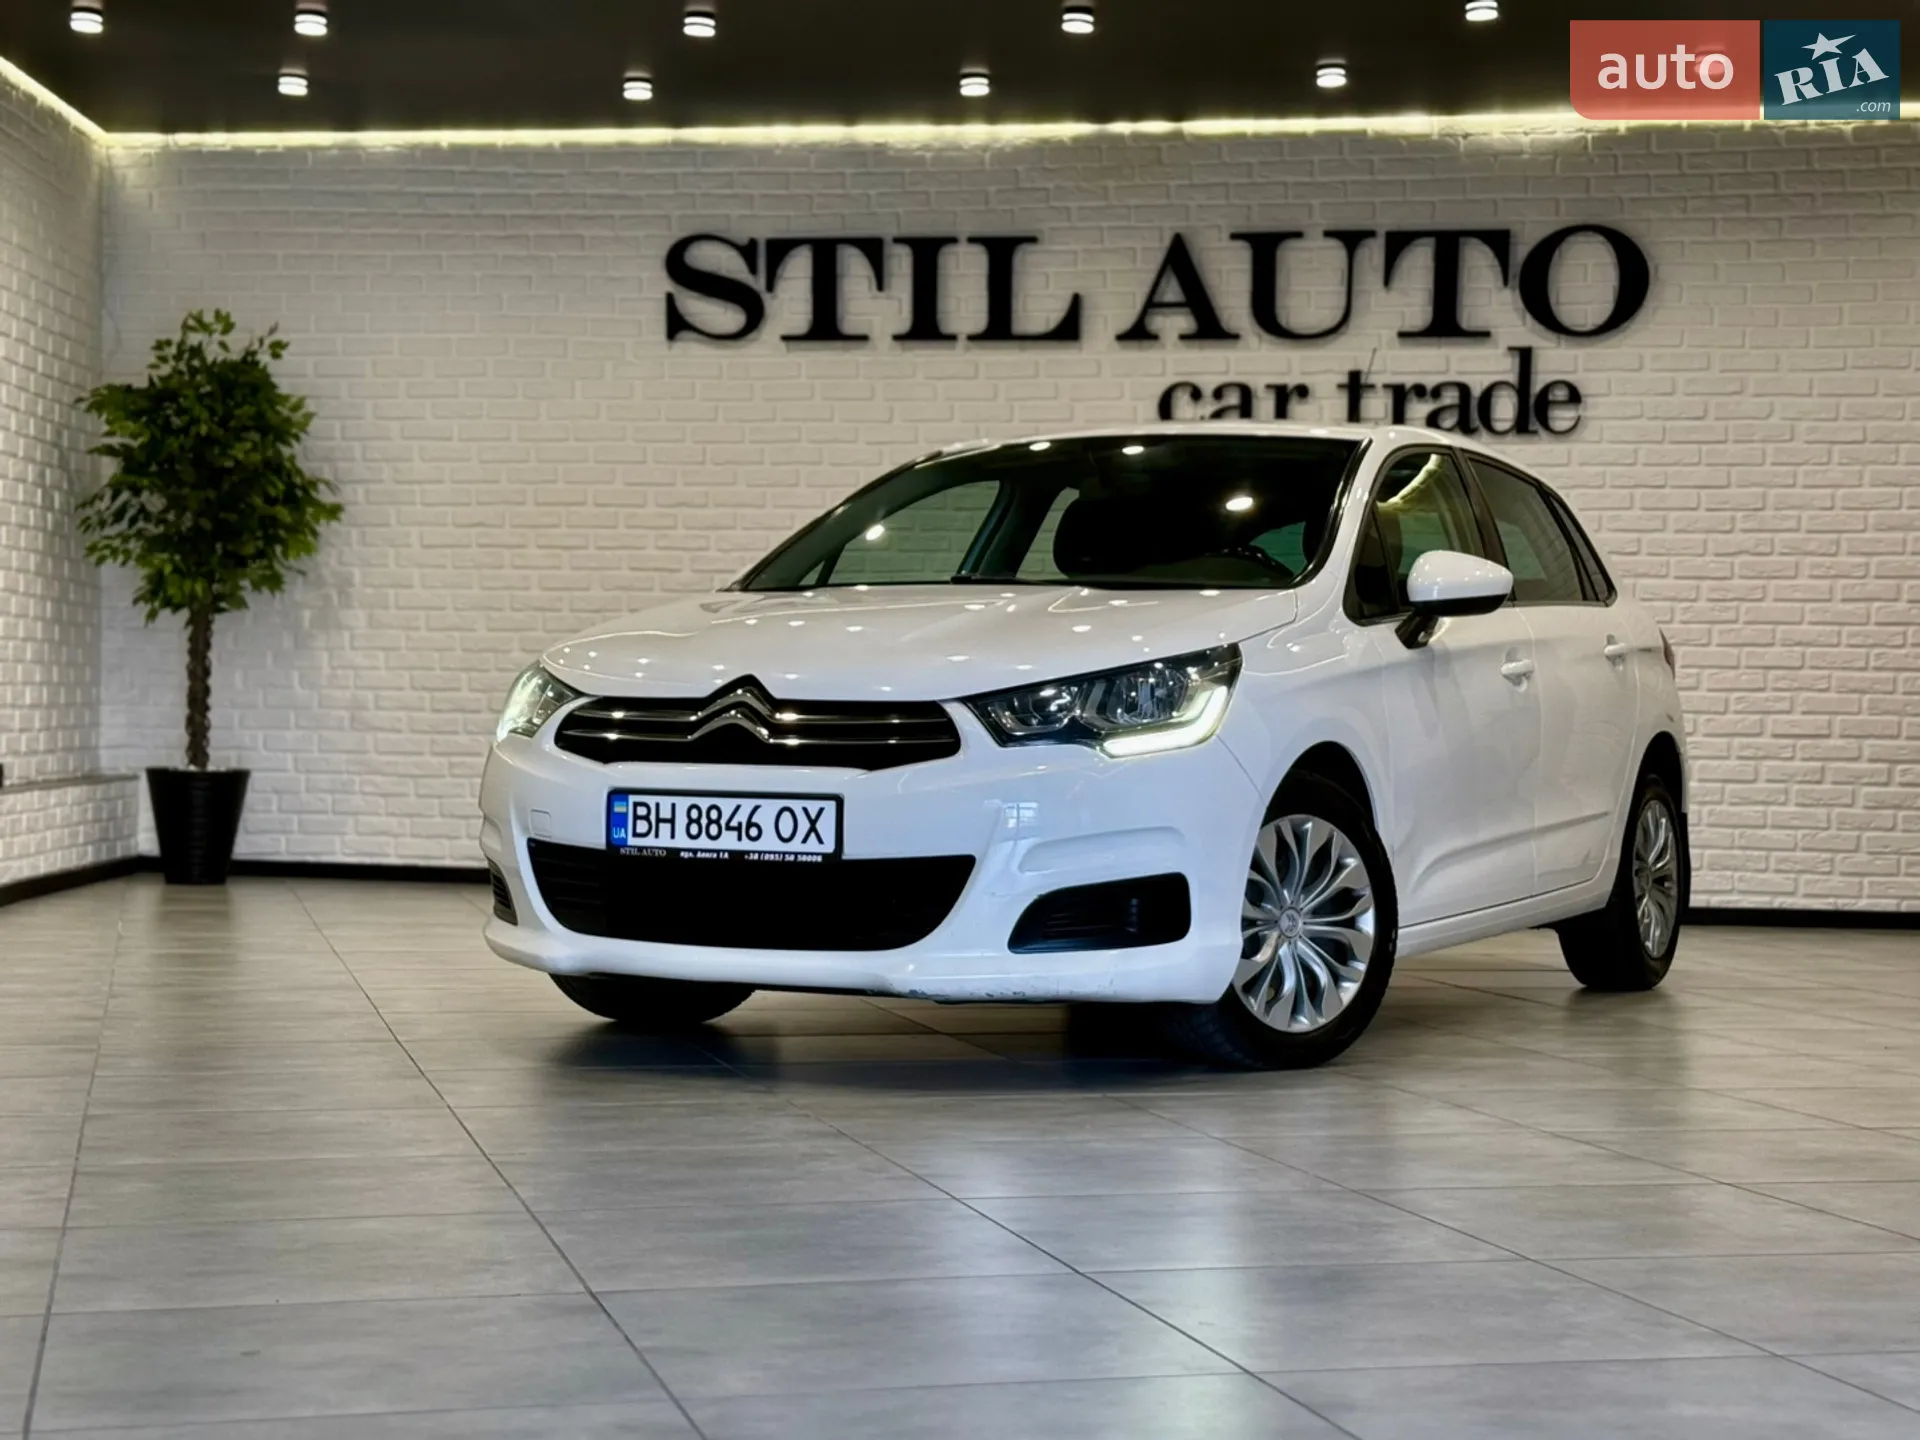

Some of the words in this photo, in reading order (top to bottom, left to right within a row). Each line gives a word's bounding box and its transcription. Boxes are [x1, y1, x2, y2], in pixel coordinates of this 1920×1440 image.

[665, 233, 1082, 342] STIL
[1115, 224, 1651, 341] AUTO
[1158, 380, 1309, 422] car
[1338, 346, 1583, 436] trade
[613, 828, 627, 839] UA
[632, 801, 676, 839] BH
[685, 804, 763, 842] 8846
[774, 806, 826, 845] OX
[620, 847, 640, 856] STIL
[641, 848, 667, 857] AUTO
